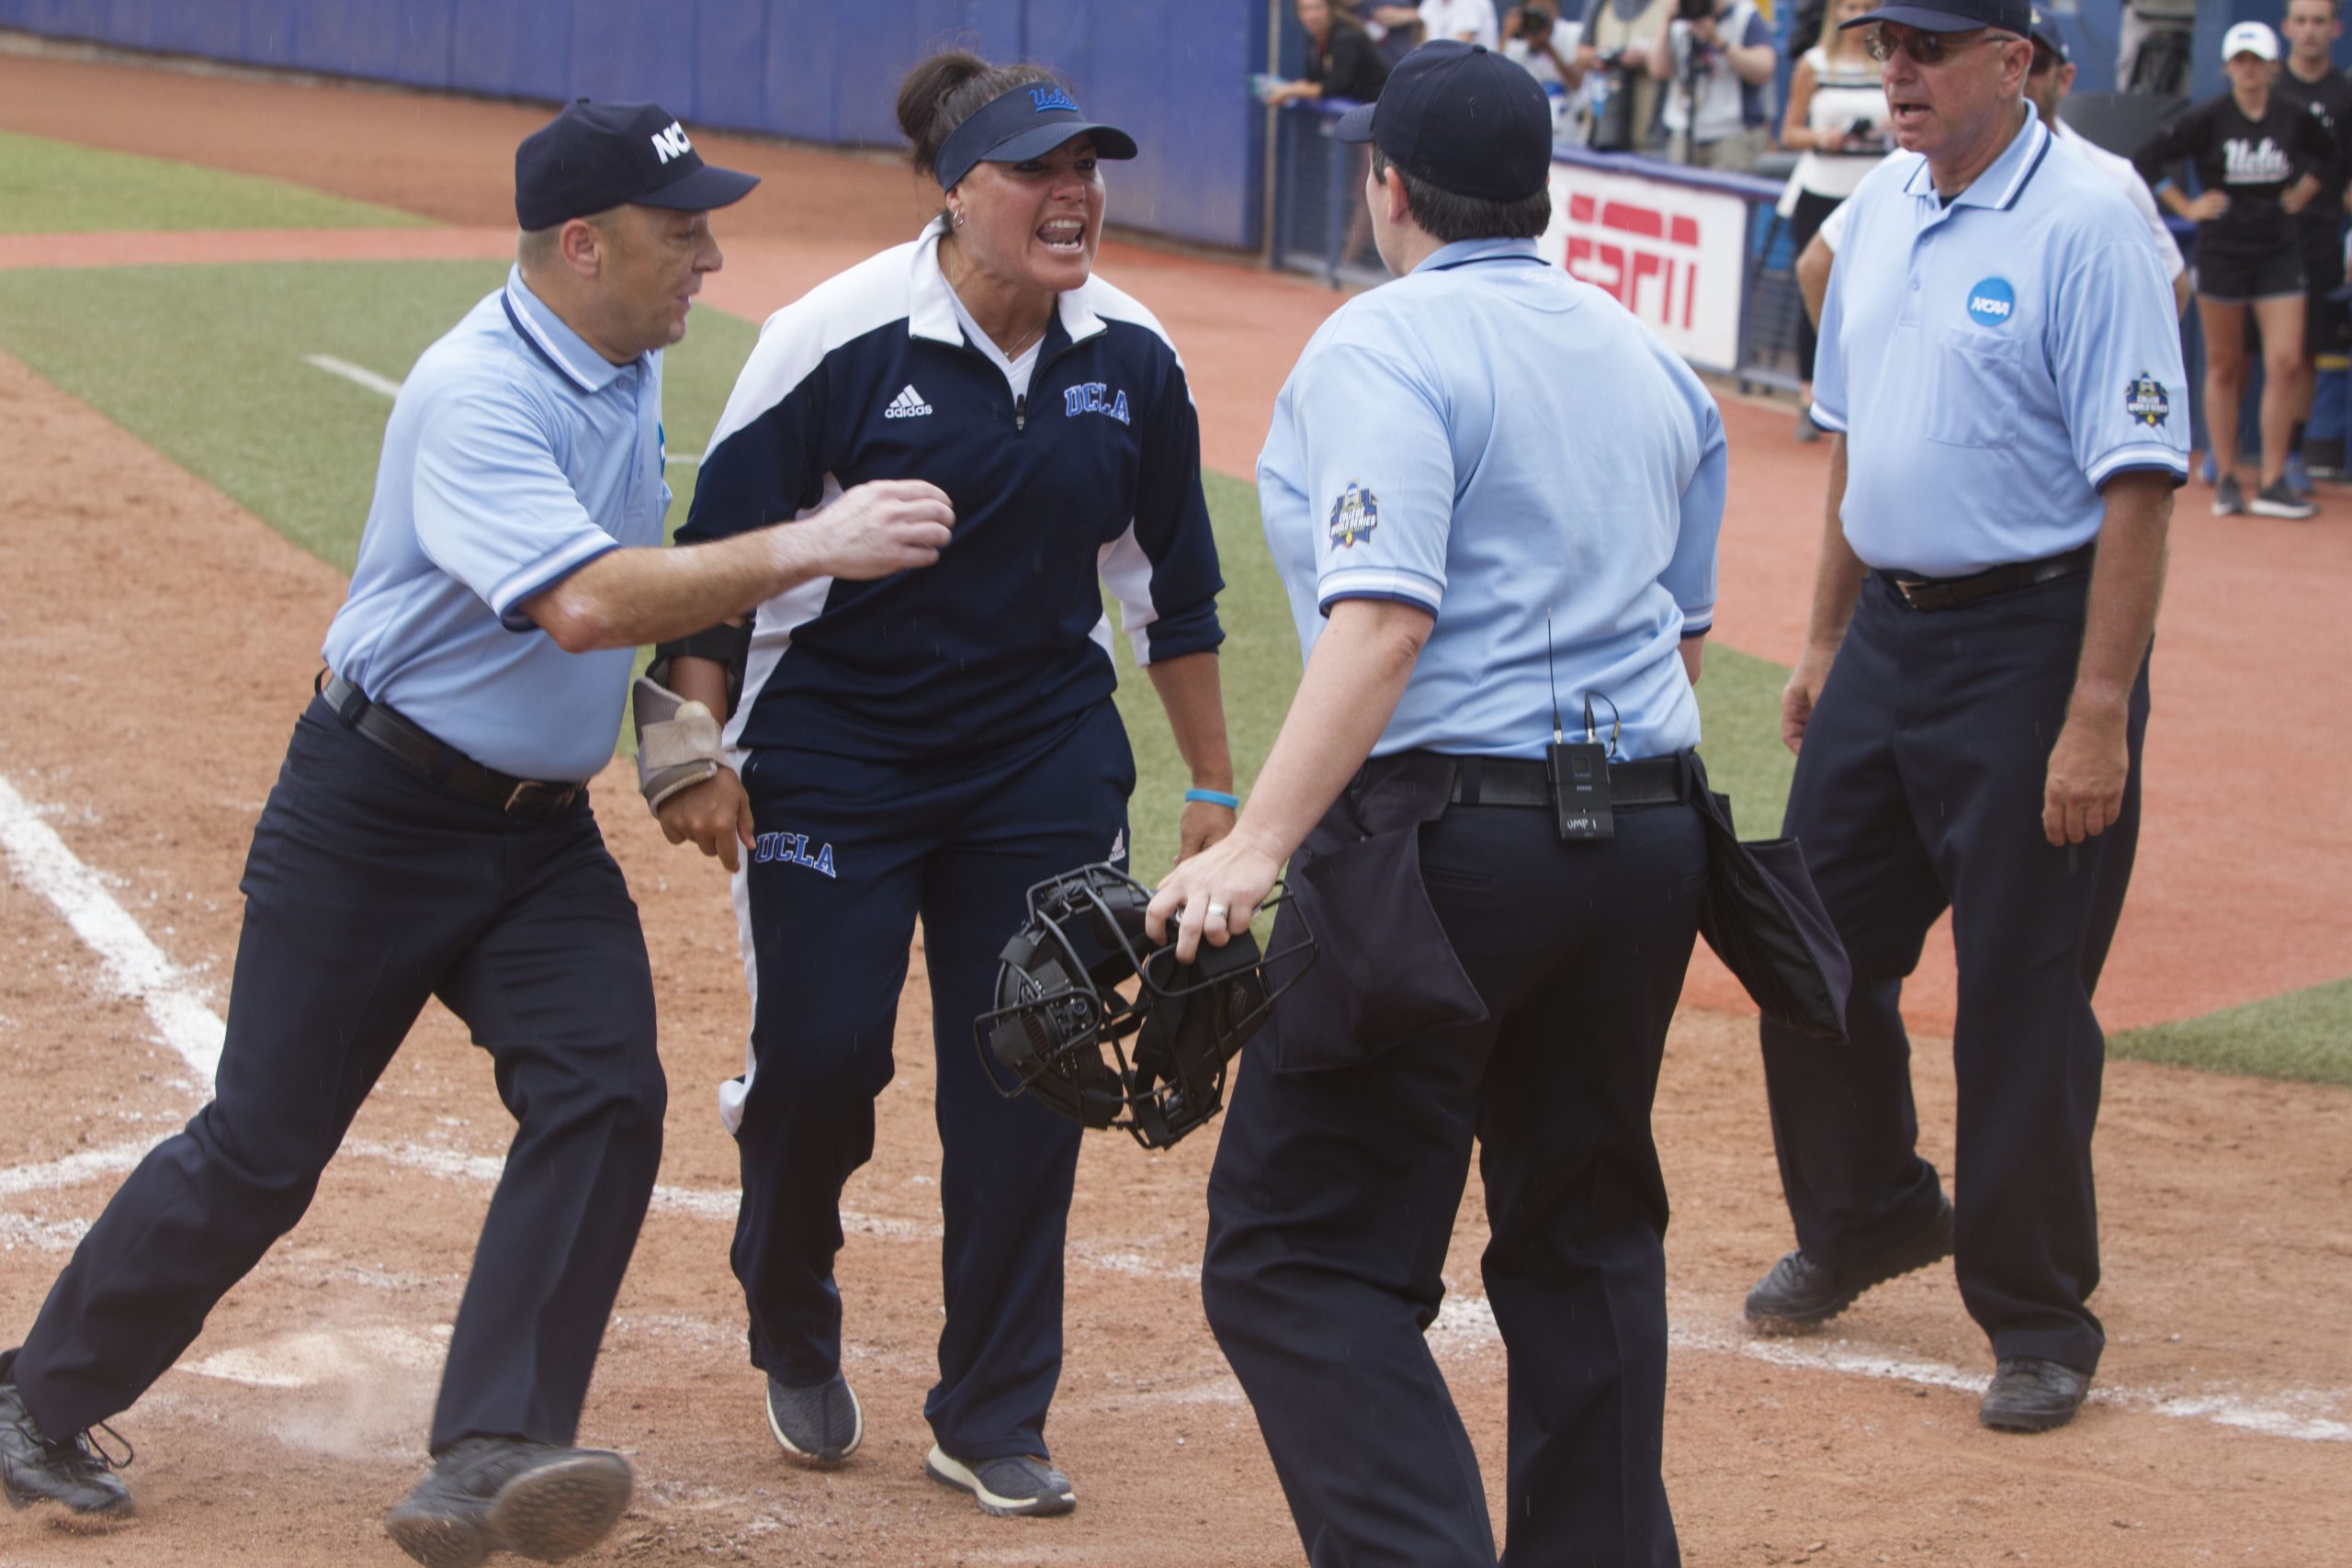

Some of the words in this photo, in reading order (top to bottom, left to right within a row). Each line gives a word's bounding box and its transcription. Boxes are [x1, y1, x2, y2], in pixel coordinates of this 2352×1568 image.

[1971, 297, 2010, 316] NCAA
[885, 404, 933, 419] adidas
[1064, 382, 1130, 425] UCLA
[1567, 818, 1589, 830] UMP
[755, 831, 836, 879] UCLA
